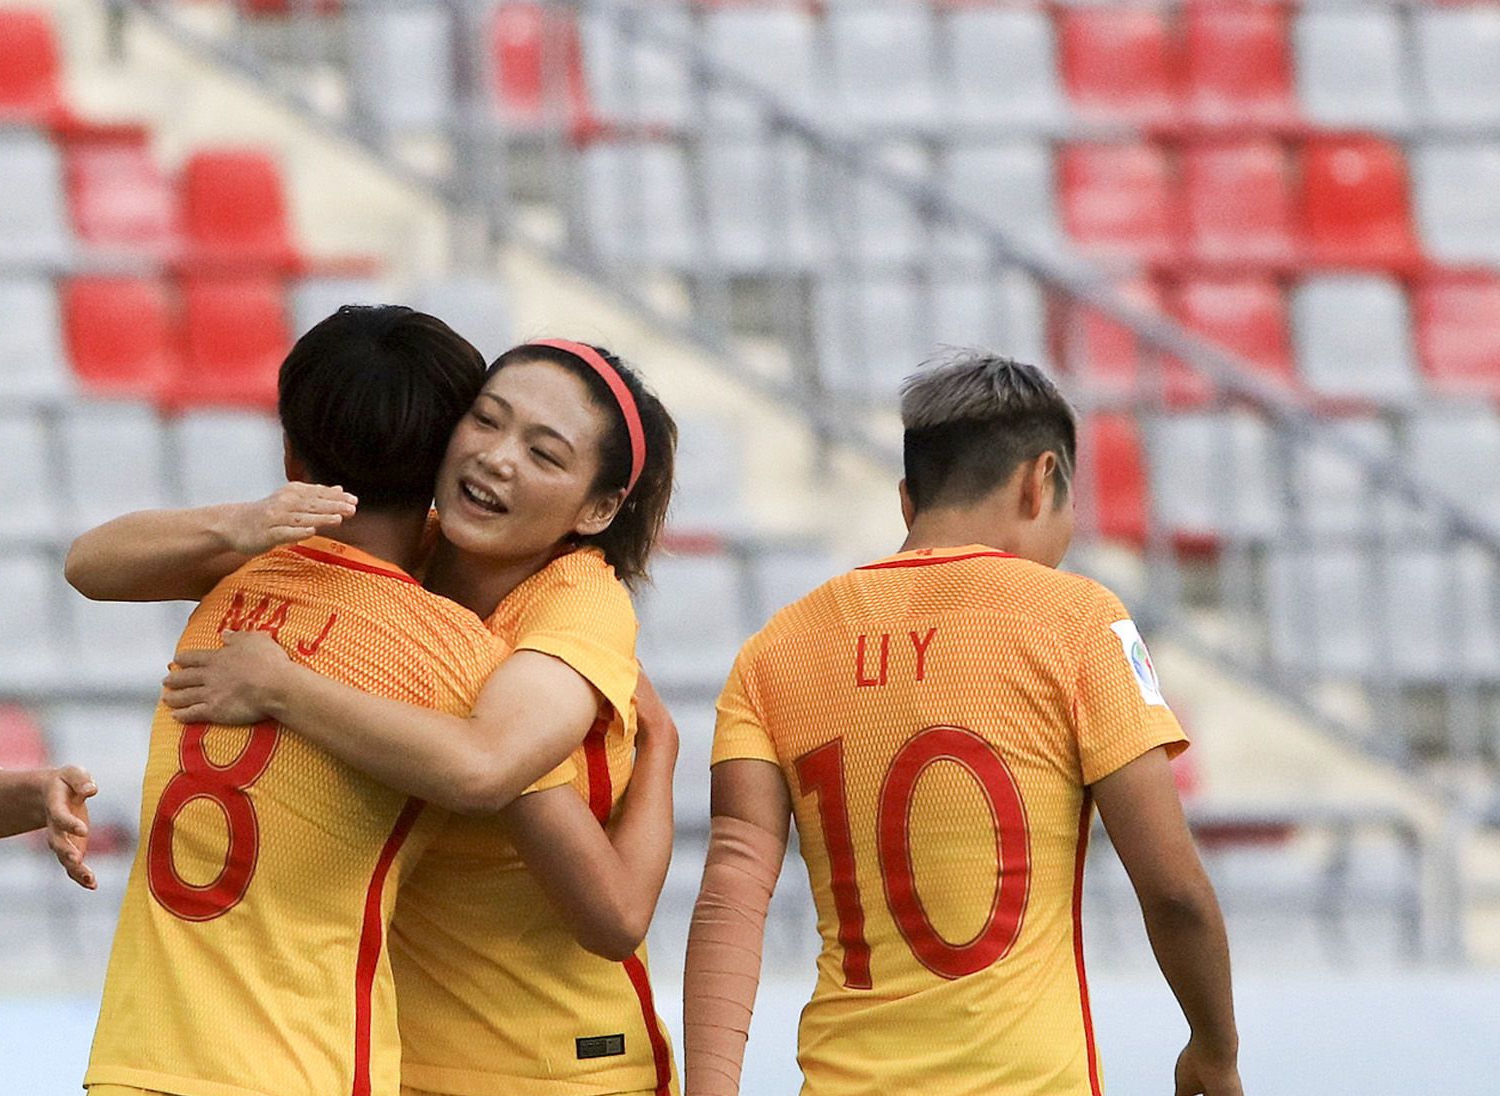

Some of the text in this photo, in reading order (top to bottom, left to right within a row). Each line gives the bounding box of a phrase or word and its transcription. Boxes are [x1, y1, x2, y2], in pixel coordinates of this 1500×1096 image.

[297, 611, 338, 656] J
[855, 626, 938, 688] LI Y
[147, 723, 281, 923] 8
[794, 725, 1031, 990] 10
